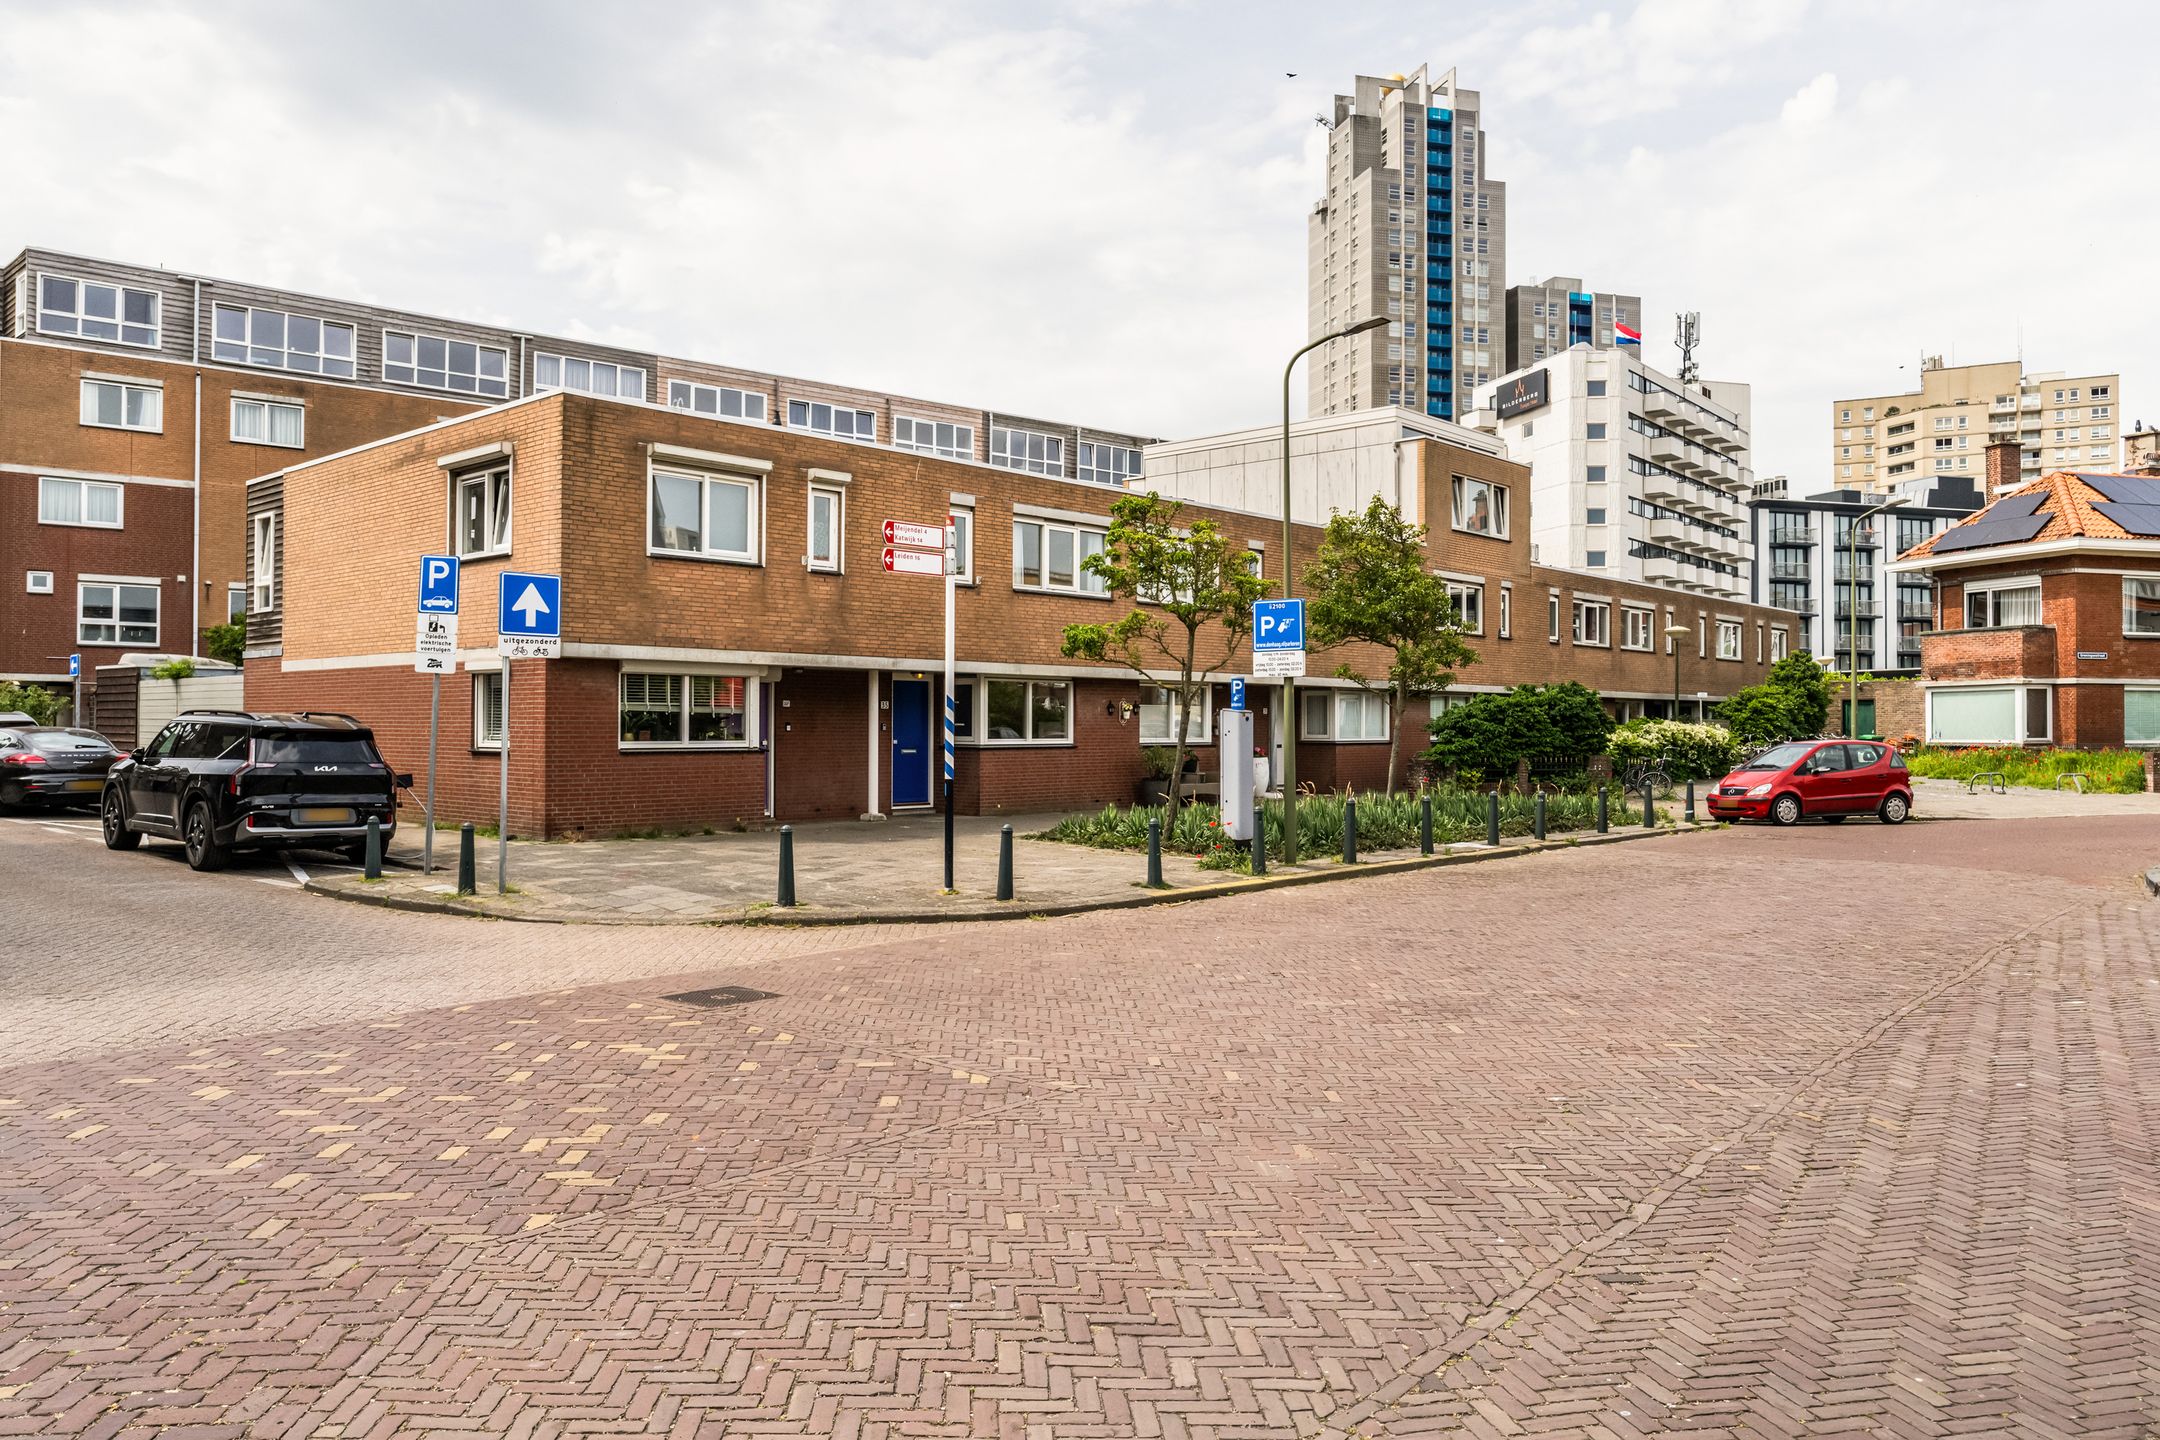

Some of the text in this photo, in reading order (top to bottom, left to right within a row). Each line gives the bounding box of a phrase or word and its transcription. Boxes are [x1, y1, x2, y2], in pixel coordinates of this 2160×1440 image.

[895, 524, 923, 534] Meijendel
[895, 534, 916, 544] Katwijk
[895, 552, 914, 560] Leiden
[428, 560, 450, 589] P
[1260, 616, 1275, 637] P
[503, 637, 557, 645] uitgezonderd
[1233, 680, 1242, 694] P
